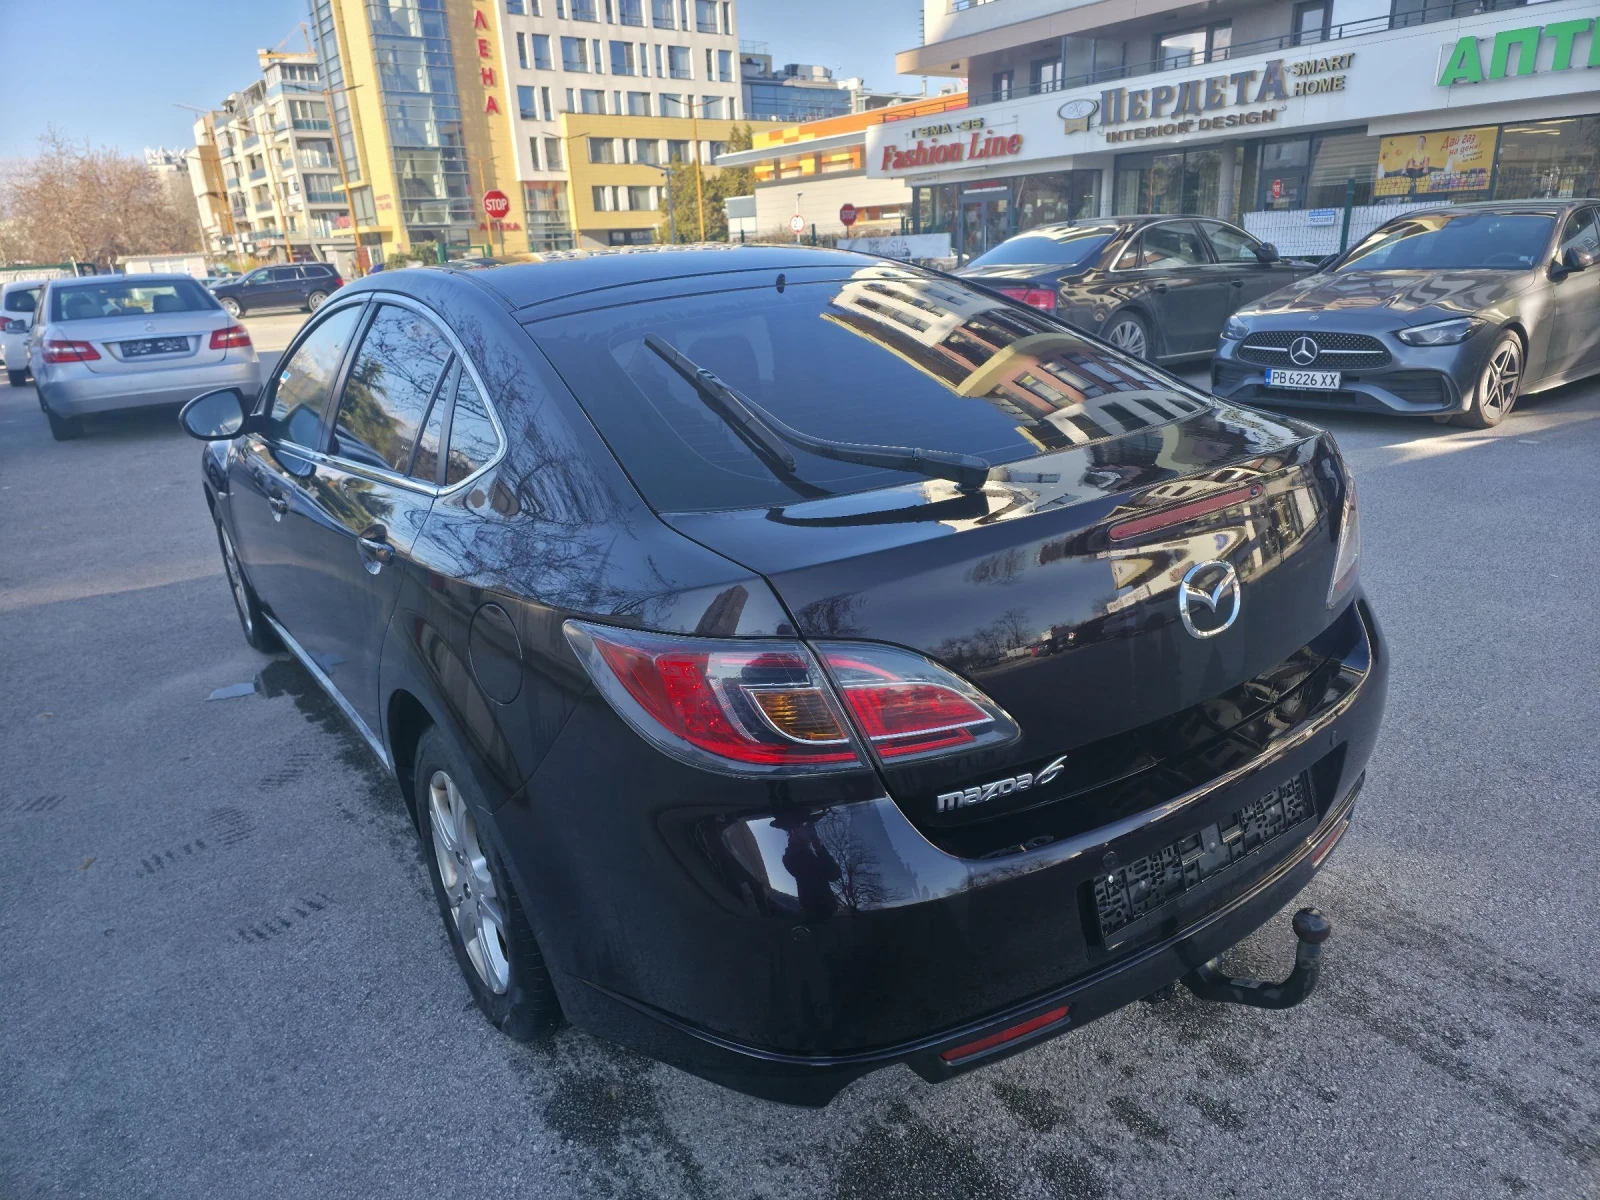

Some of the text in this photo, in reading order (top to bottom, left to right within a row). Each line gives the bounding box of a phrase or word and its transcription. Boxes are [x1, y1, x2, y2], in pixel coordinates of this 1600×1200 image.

[1291, 52, 1355, 77] SMART
[1100, 58, 1288, 126] ПЕРДЕТА
[1293, 75, 1346, 96] HOME
[1106, 108, 1277, 143] INTERIOR DESIGN
[881, 129, 1023, 171] Fashion Line
[485, 198, 508, 211] STOP
[841, 209, 856, 219] STOP
[1272, 371, 1337, 387] PB 6226 XX
